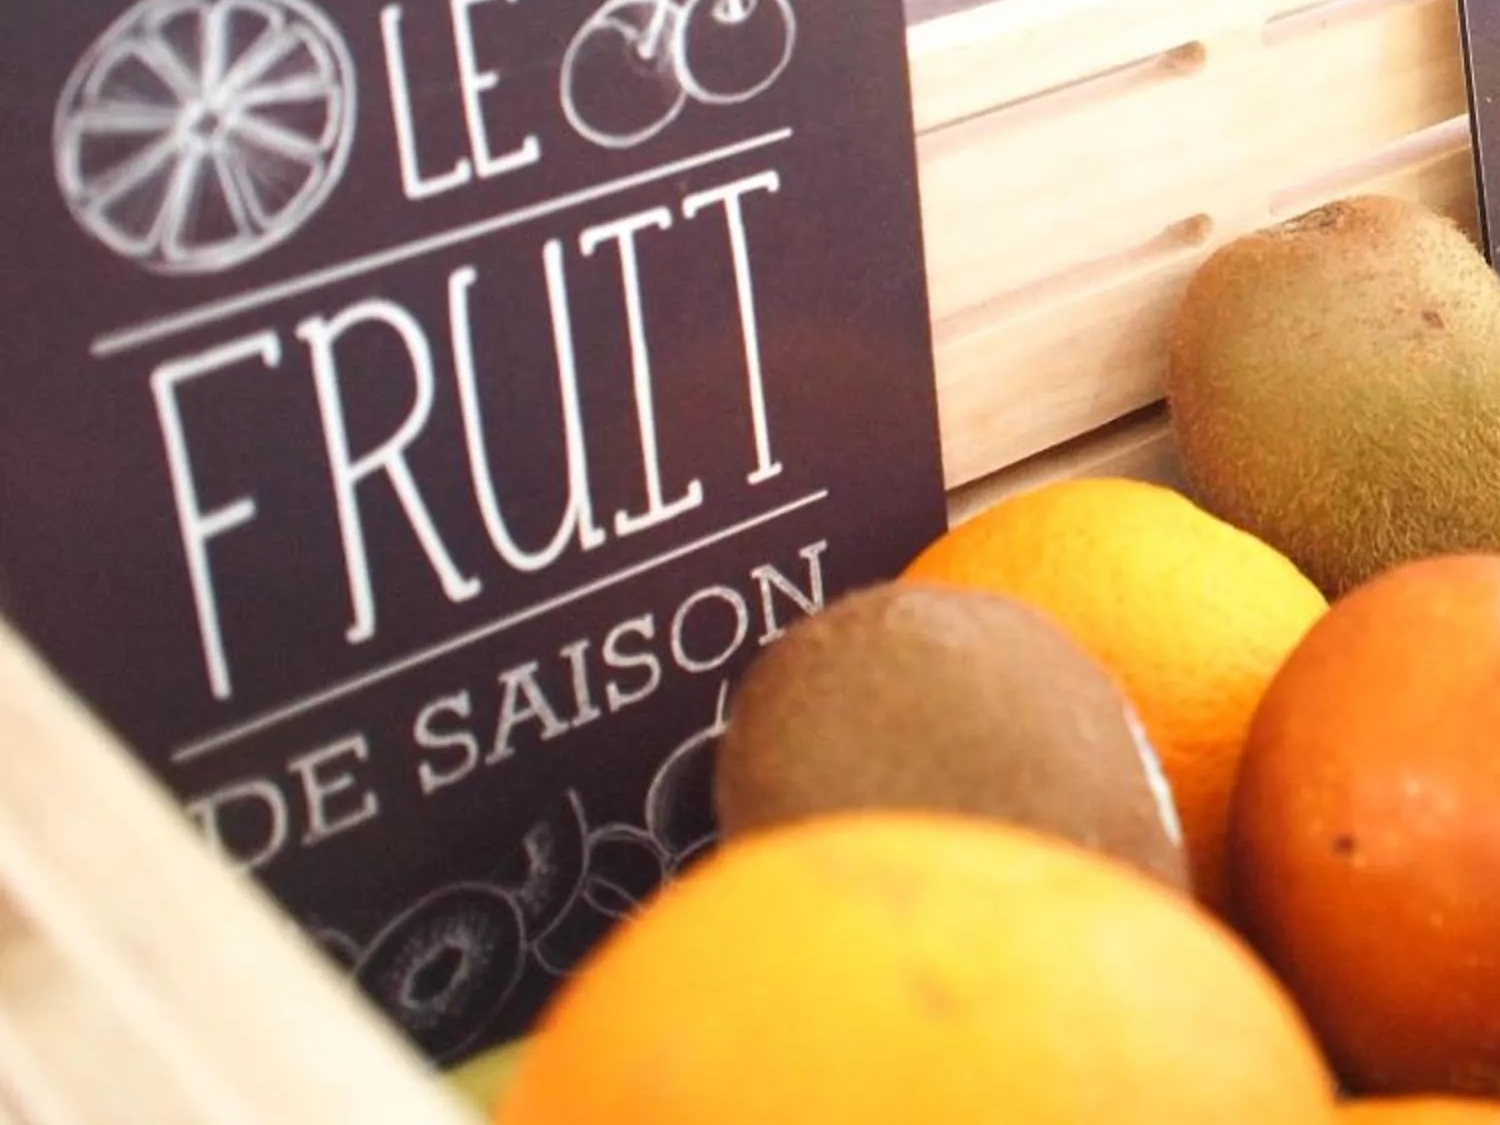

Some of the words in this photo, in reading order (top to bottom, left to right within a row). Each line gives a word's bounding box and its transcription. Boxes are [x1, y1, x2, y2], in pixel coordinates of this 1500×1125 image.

[150, 169, 783, 700] FRUIT
[182, 734, 379, 873] DE
[411, 539, 829, 795] SAISON
